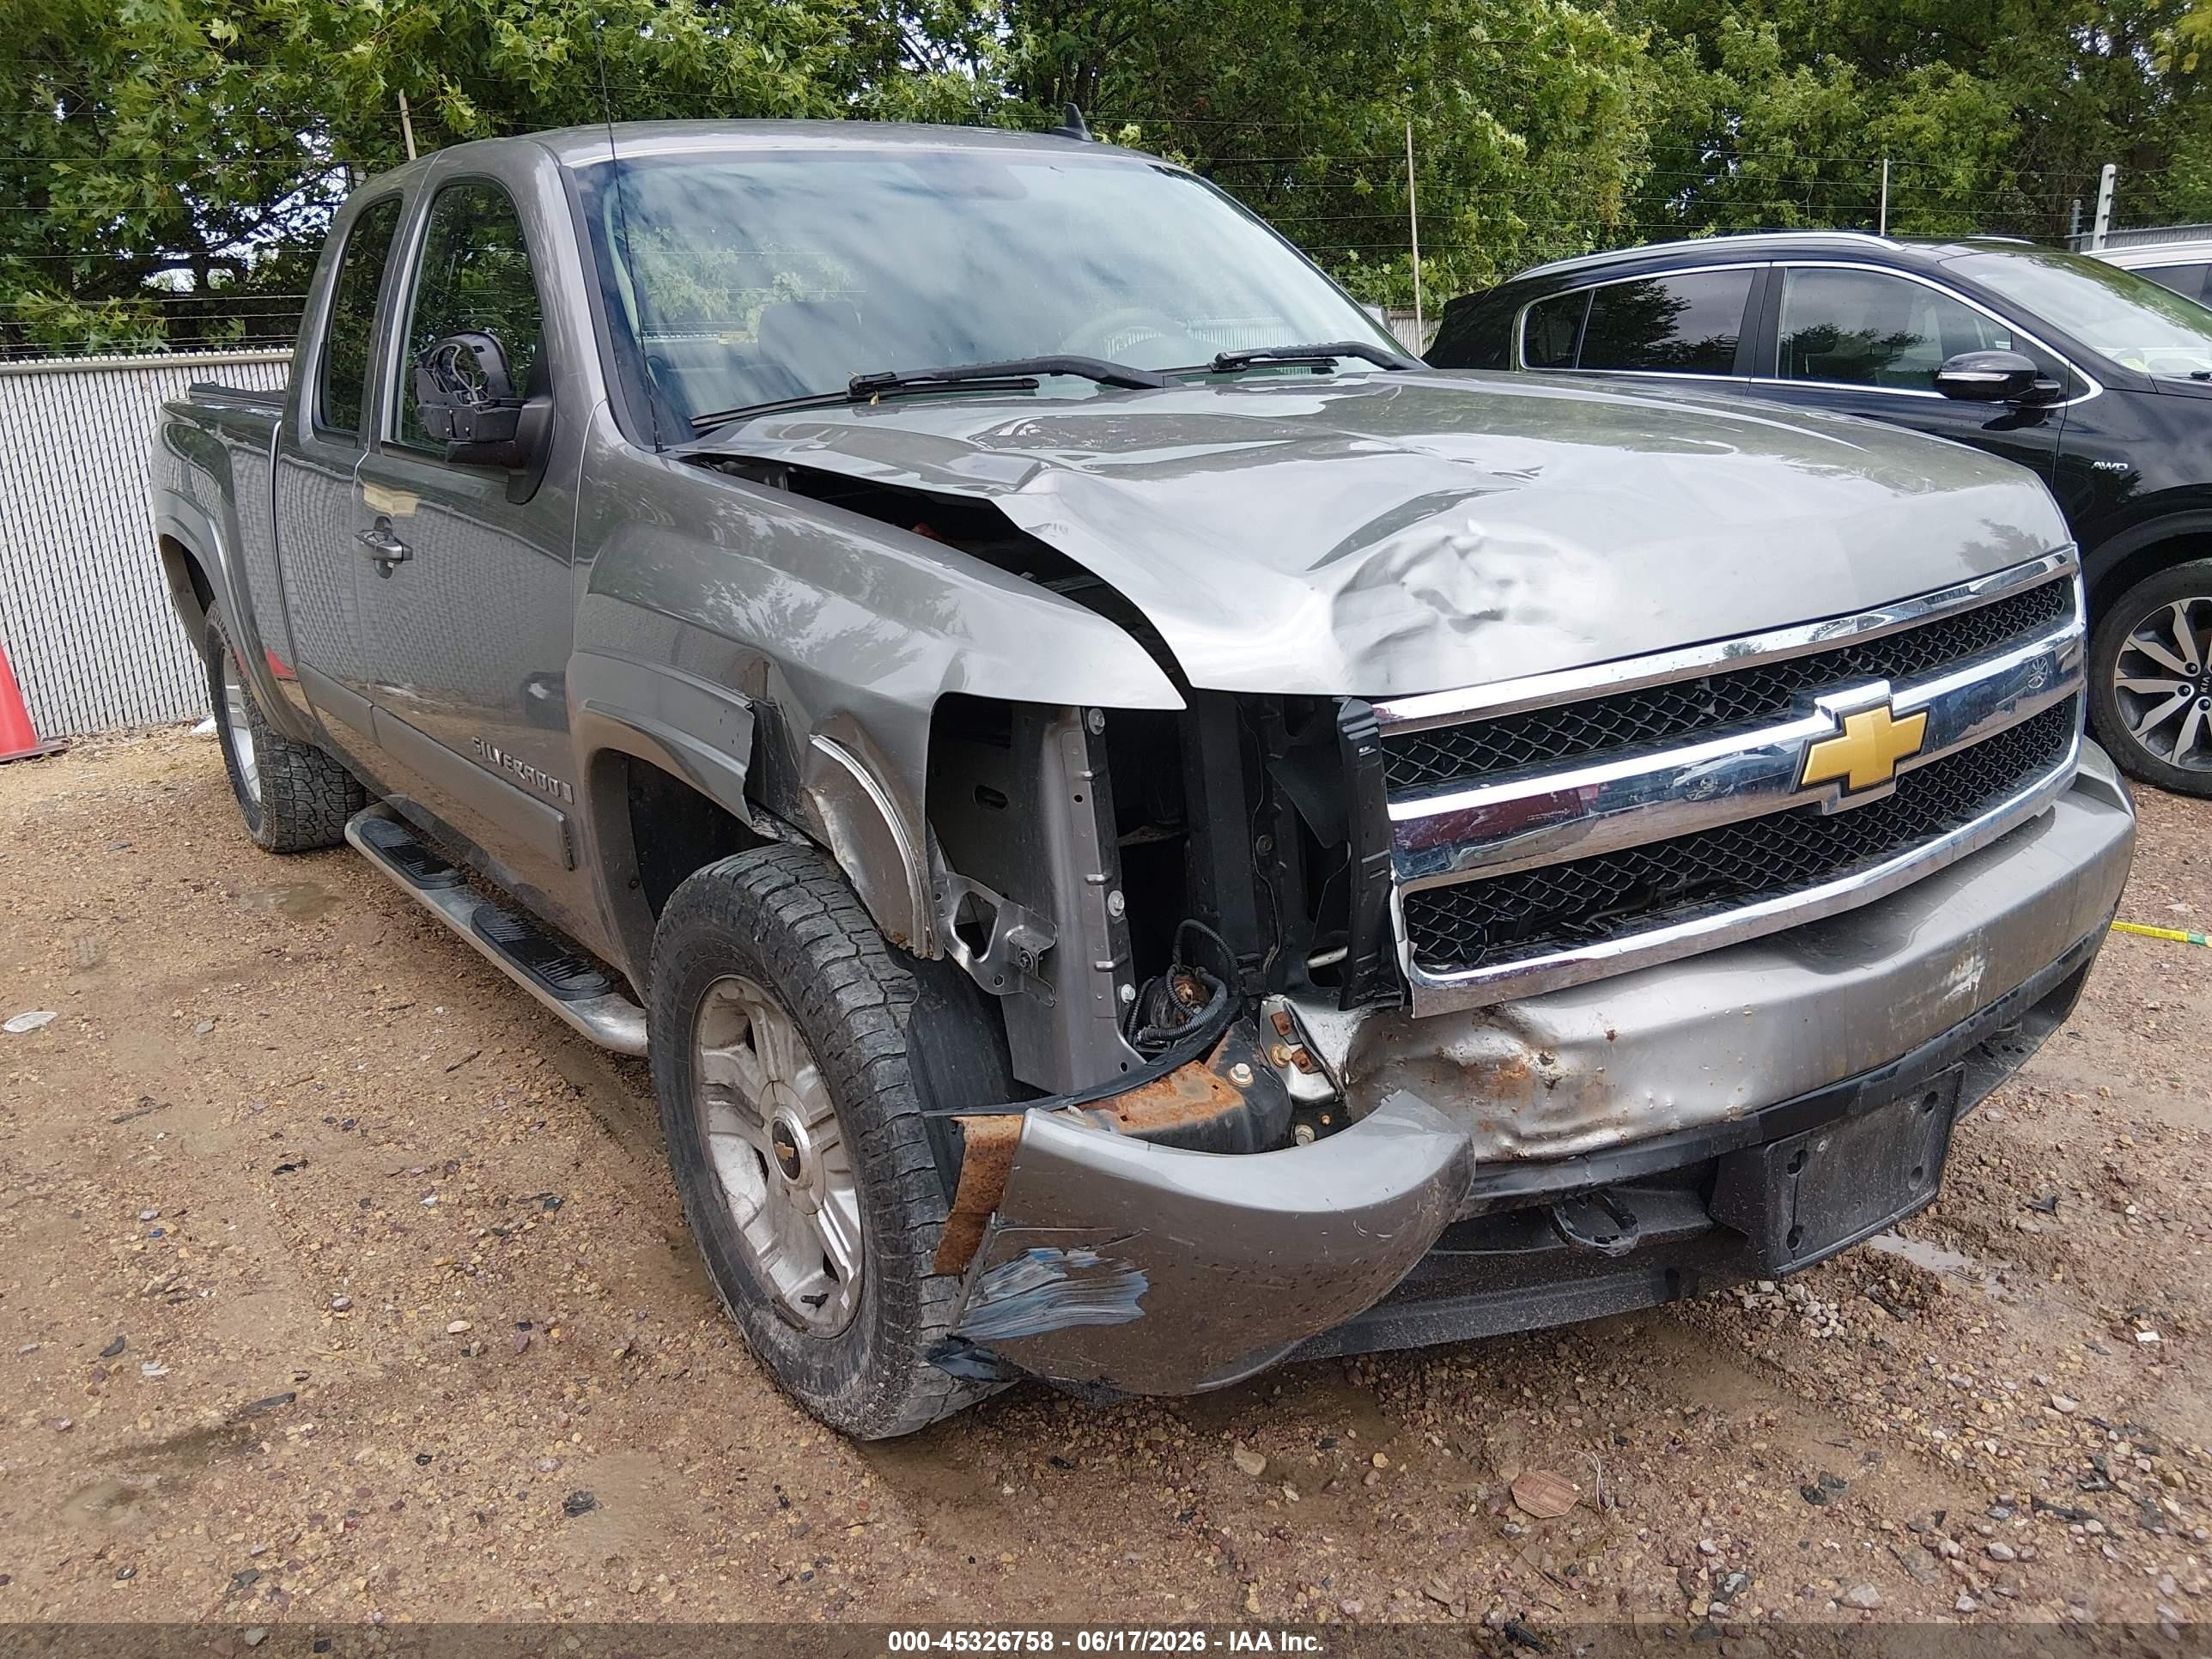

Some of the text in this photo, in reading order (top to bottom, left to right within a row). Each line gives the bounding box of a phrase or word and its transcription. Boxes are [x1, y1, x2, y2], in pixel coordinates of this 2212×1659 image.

[2090, 461, 2128, 471] AWD
[2200, 677, 2210, 693] KIA
[471, 736, 560, 797] SILVERADO
